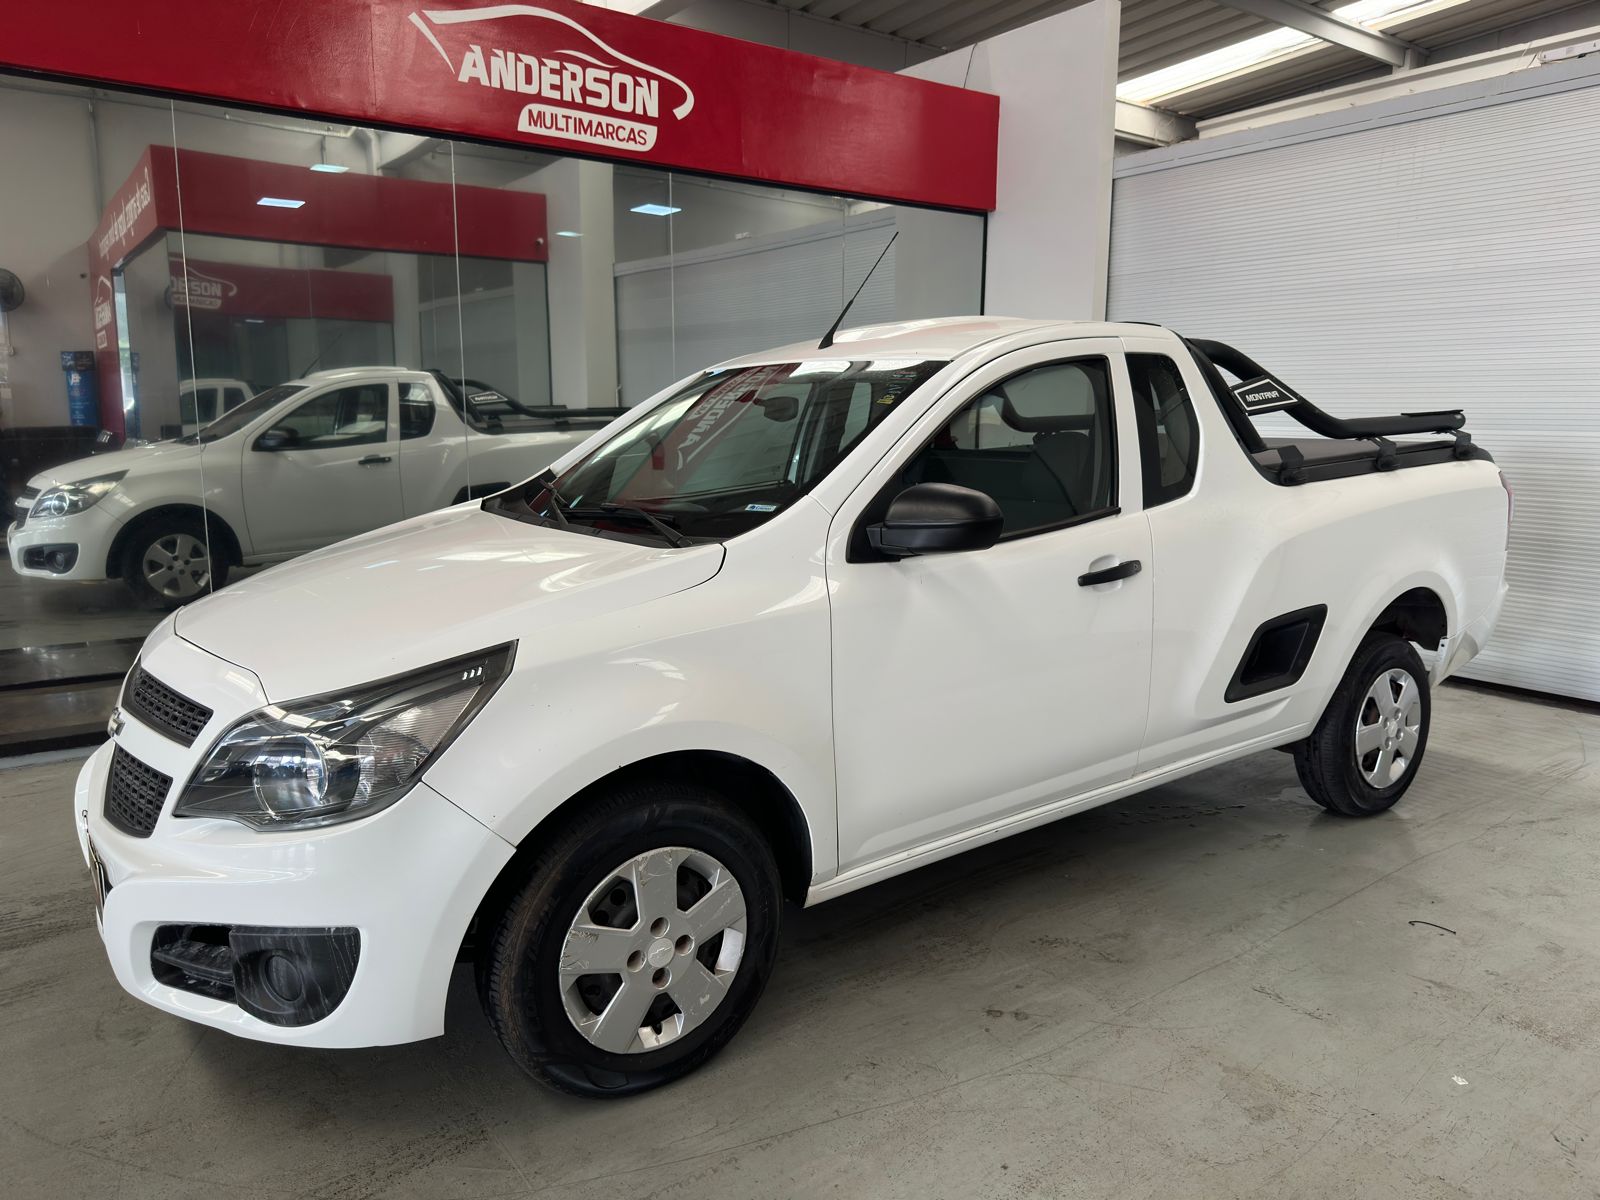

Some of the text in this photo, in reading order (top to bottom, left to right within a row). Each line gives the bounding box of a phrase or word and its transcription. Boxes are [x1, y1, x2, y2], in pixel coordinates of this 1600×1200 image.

[458, 44, 659, 118] ANDERSON
[527, 108, 648, 146] MULTIMARCAS
[1245, 390, 1280, 402] MONTANA
